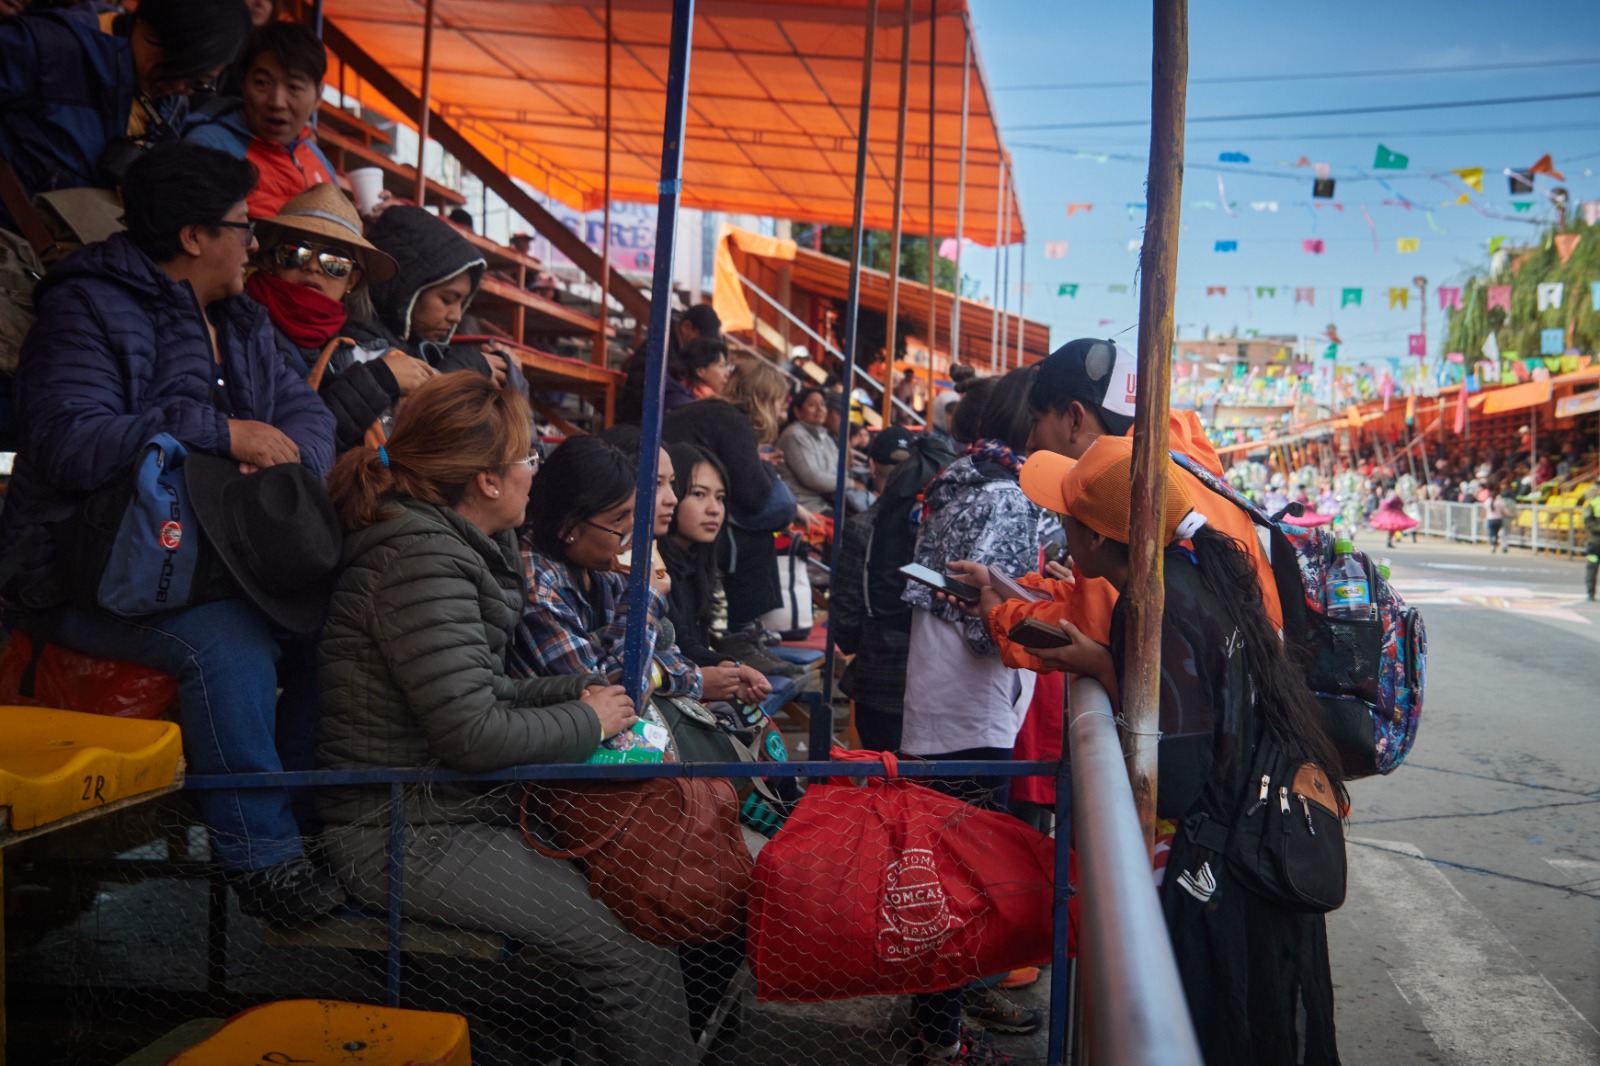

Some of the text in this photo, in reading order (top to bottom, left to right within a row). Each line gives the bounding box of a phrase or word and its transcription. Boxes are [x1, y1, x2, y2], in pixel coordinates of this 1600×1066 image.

[81, 774, 105, 804] 2R
[885, 887, 943, 904] COMCAS
[888, 945, 910, 955] OUR
